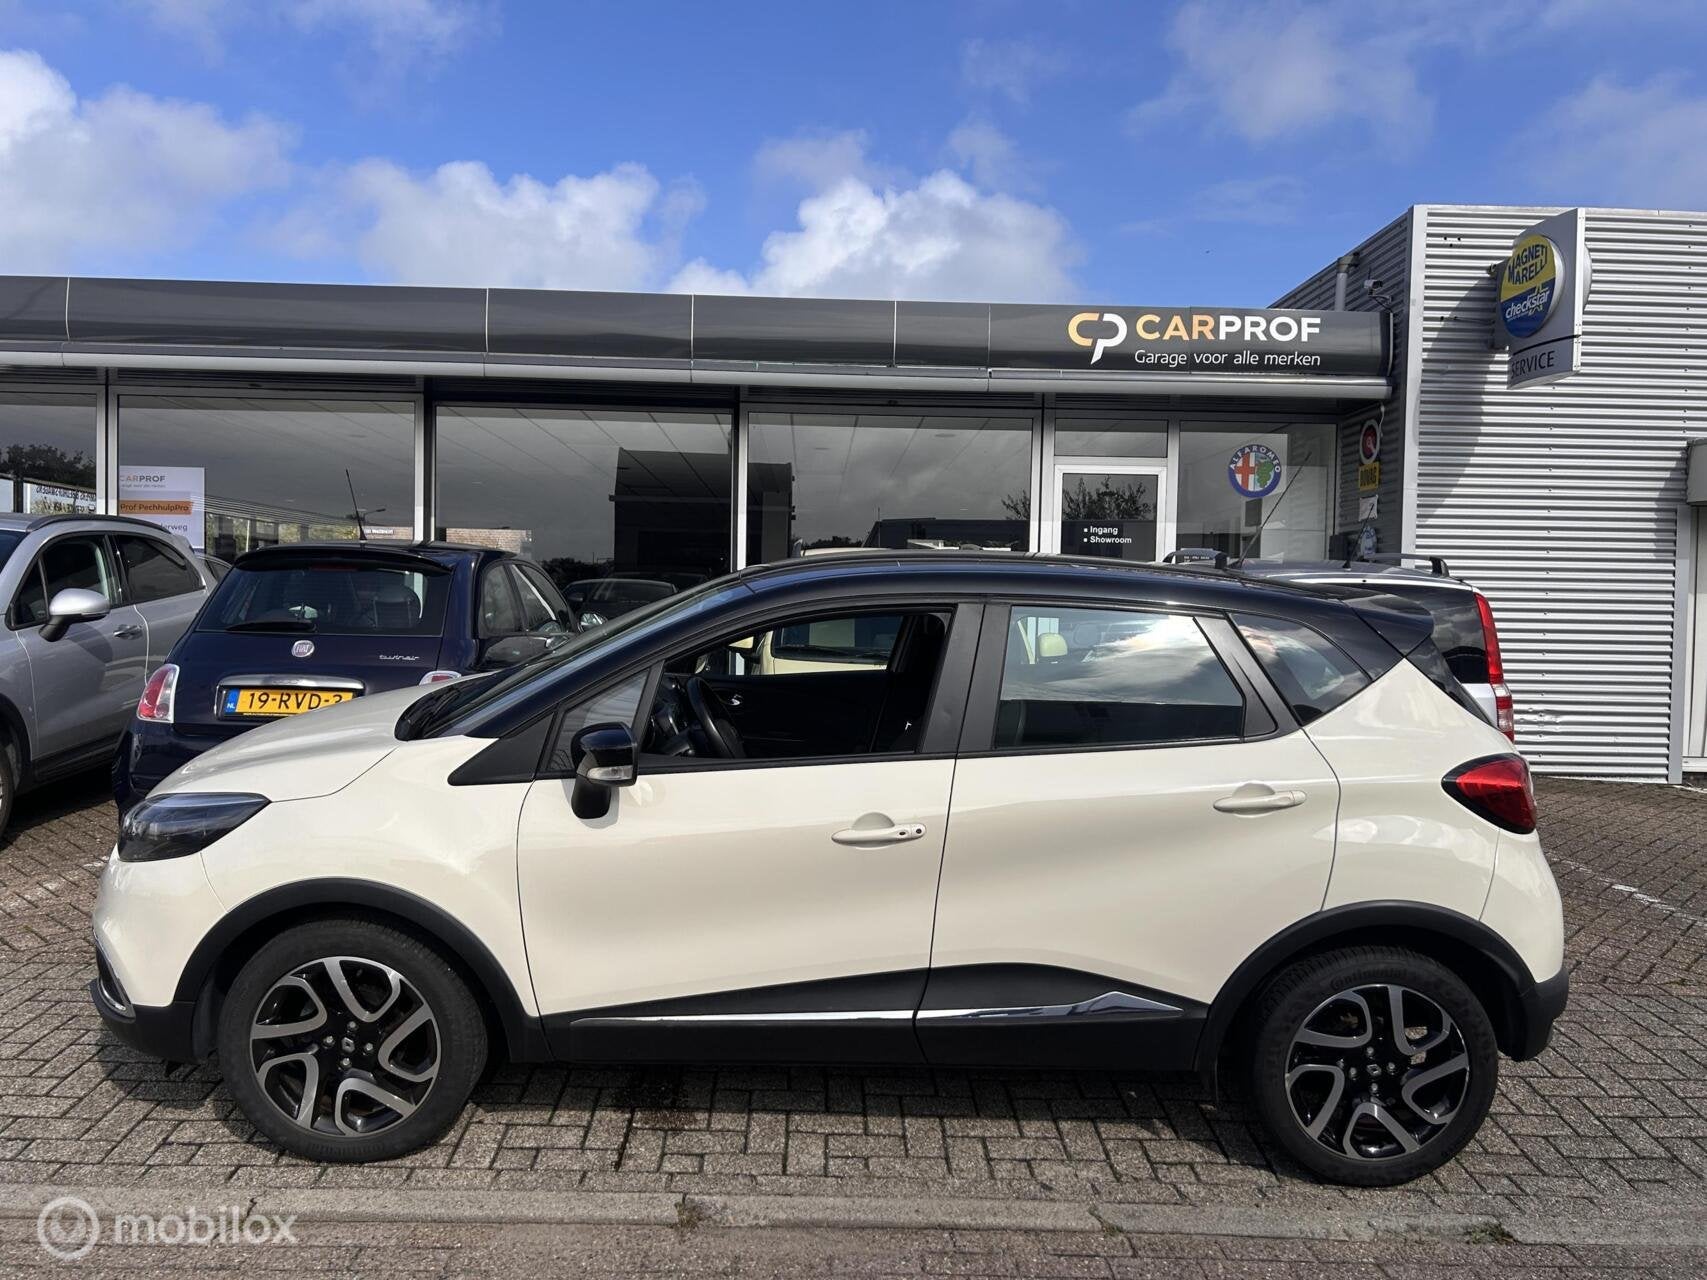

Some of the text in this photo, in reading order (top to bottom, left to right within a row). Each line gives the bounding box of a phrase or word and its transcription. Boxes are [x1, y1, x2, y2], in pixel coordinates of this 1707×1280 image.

[1508, 244, 1547, 272] MAGNETI
[1508, 258, 1547, 285] MARELLI
[1505, 291, 1550, 319] checkstar
[1135, 313, 1321, 343] CARPROF
[1134, 349, 1321, 368] Garage voor alle merken
[1511, 350, 1555, 379] SERVICE
[120, 503, 137, 511] Prof
[1089, 526, 1118, 535] Ingang
[1089, 536, 1132, 544] Showroom
